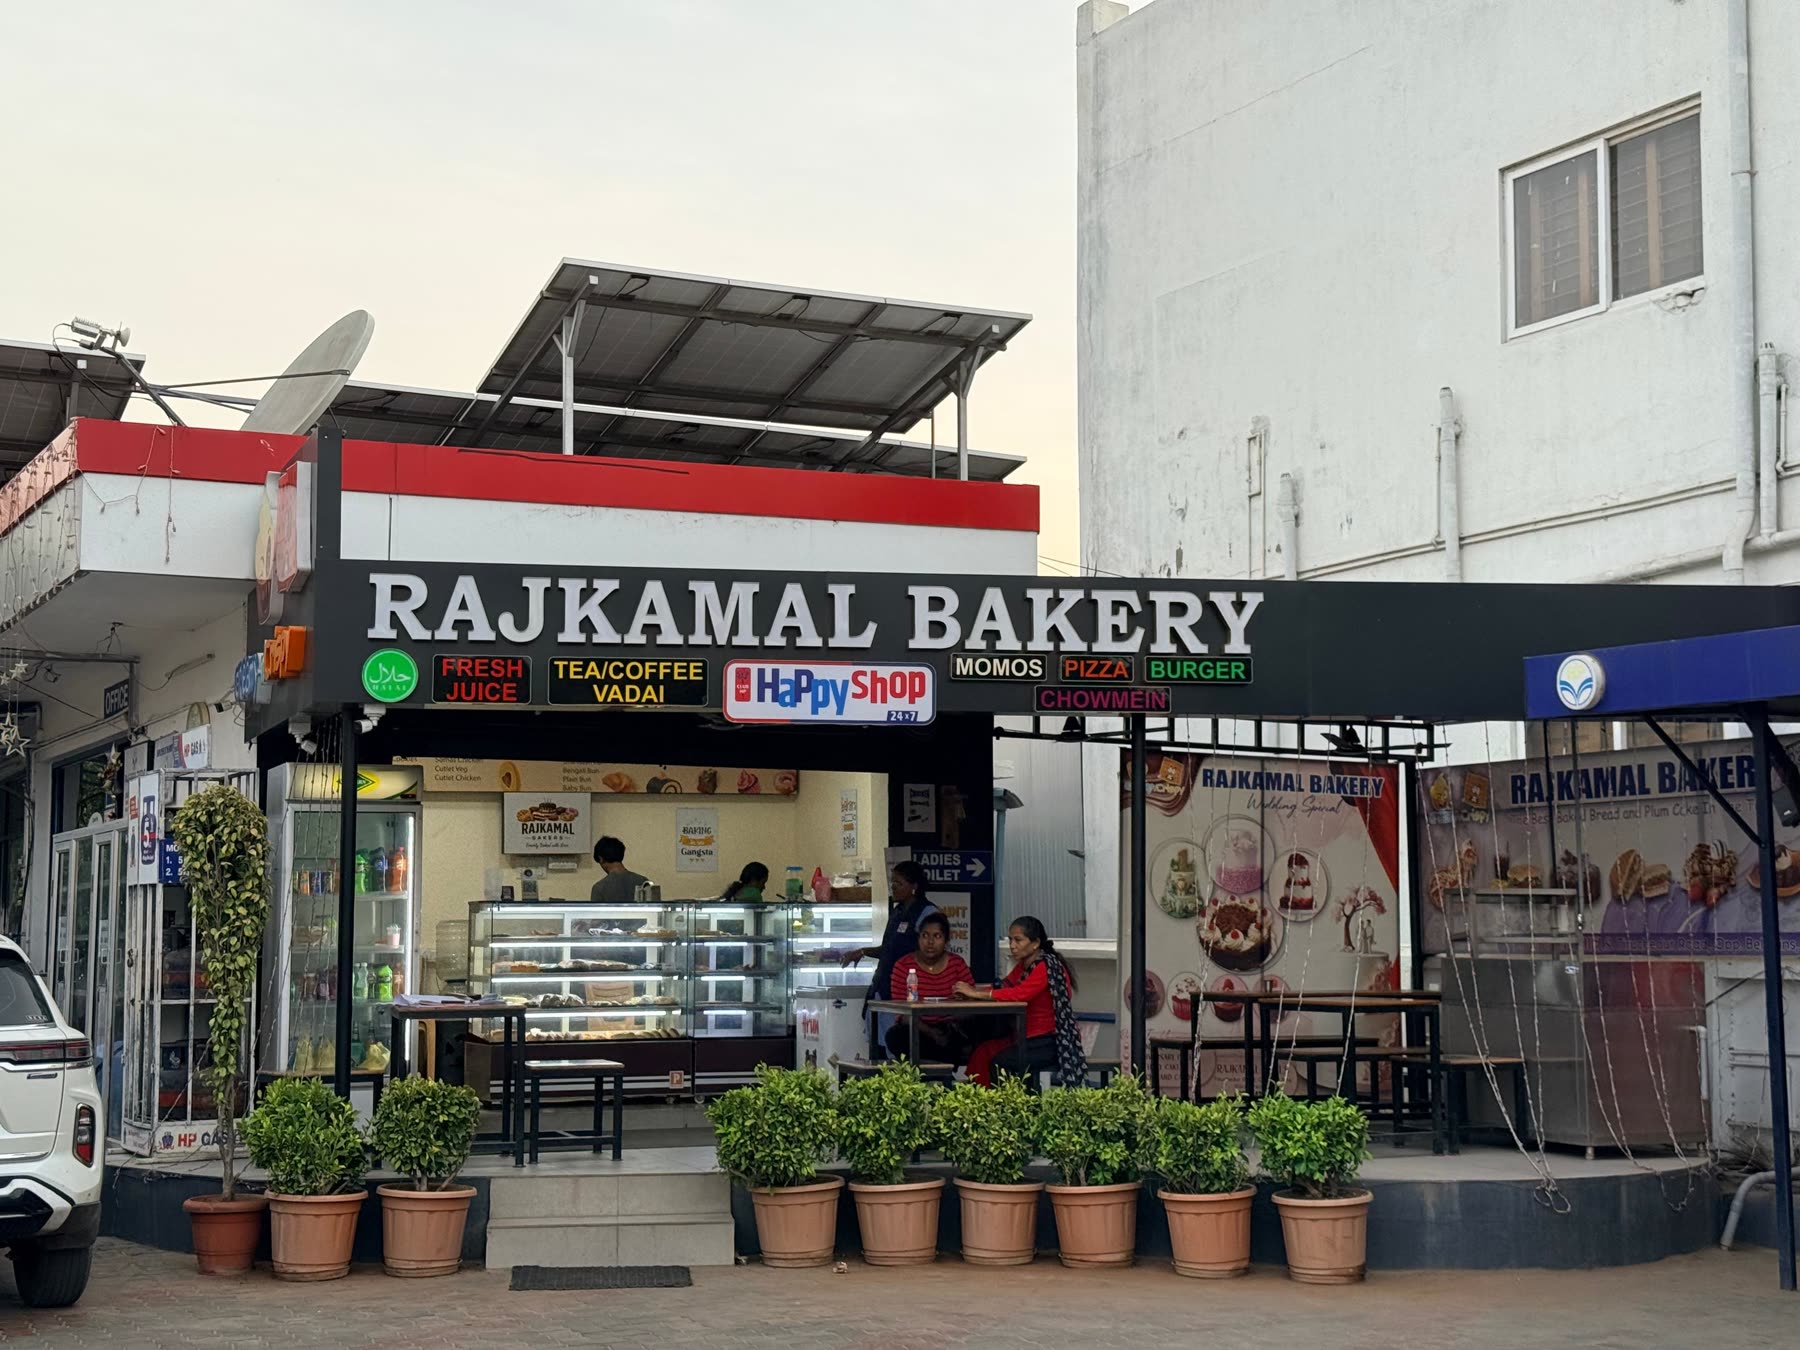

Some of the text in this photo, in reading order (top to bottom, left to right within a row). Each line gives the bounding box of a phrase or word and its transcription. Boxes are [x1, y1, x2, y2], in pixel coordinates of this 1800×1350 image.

[367, 573, 1264, 655] RAJKAMAL BAKERY
[369, 662, 412, 684] حلال
[442, 658, 523, 678] FRESH
[554, 660, 704, 681] TEA/COFFEE
[956, 658, 1044, 678] MOMOS
[1065, 660, 1129, 680] PIZZA
[1151, 661, 1246, 681] BURGER
[446, 682, 518, 702] JUICE
[592, 684, 665, 704] VADAI
[851, 670, 926, 704] Shop
[105, 684, 128, 714] OFFICE
[1040, 690, 1166, 710] CHOWMEIN
[455, 765, 468, 773] Veg
[1202, 768, 1305, 793] RAJKAMAL
[1309, 774, 1384, 798] BAKERY
[1511, 755, 1756, 804] RAKAMAL BAKER
[1531, 812, 1550, 824] Bes
[1589, 808, 1620, 822] Bread
[1622, 805, 1641, 819] and
[1644, 804, 1669, 818] Plum
[521, 822, 575, 835] RAJKAMAL
[681, 826, 712, 835] BAKING
[166, 856, 172, 865] 1.
[681, 847, 714, 858] Gangsta
[912, 853, 961, 866] LADIES
[165, 868, 173, 877] 2.
[923, 869, 961, 881] ILET
[177, 1133, 197, 1147] HP
